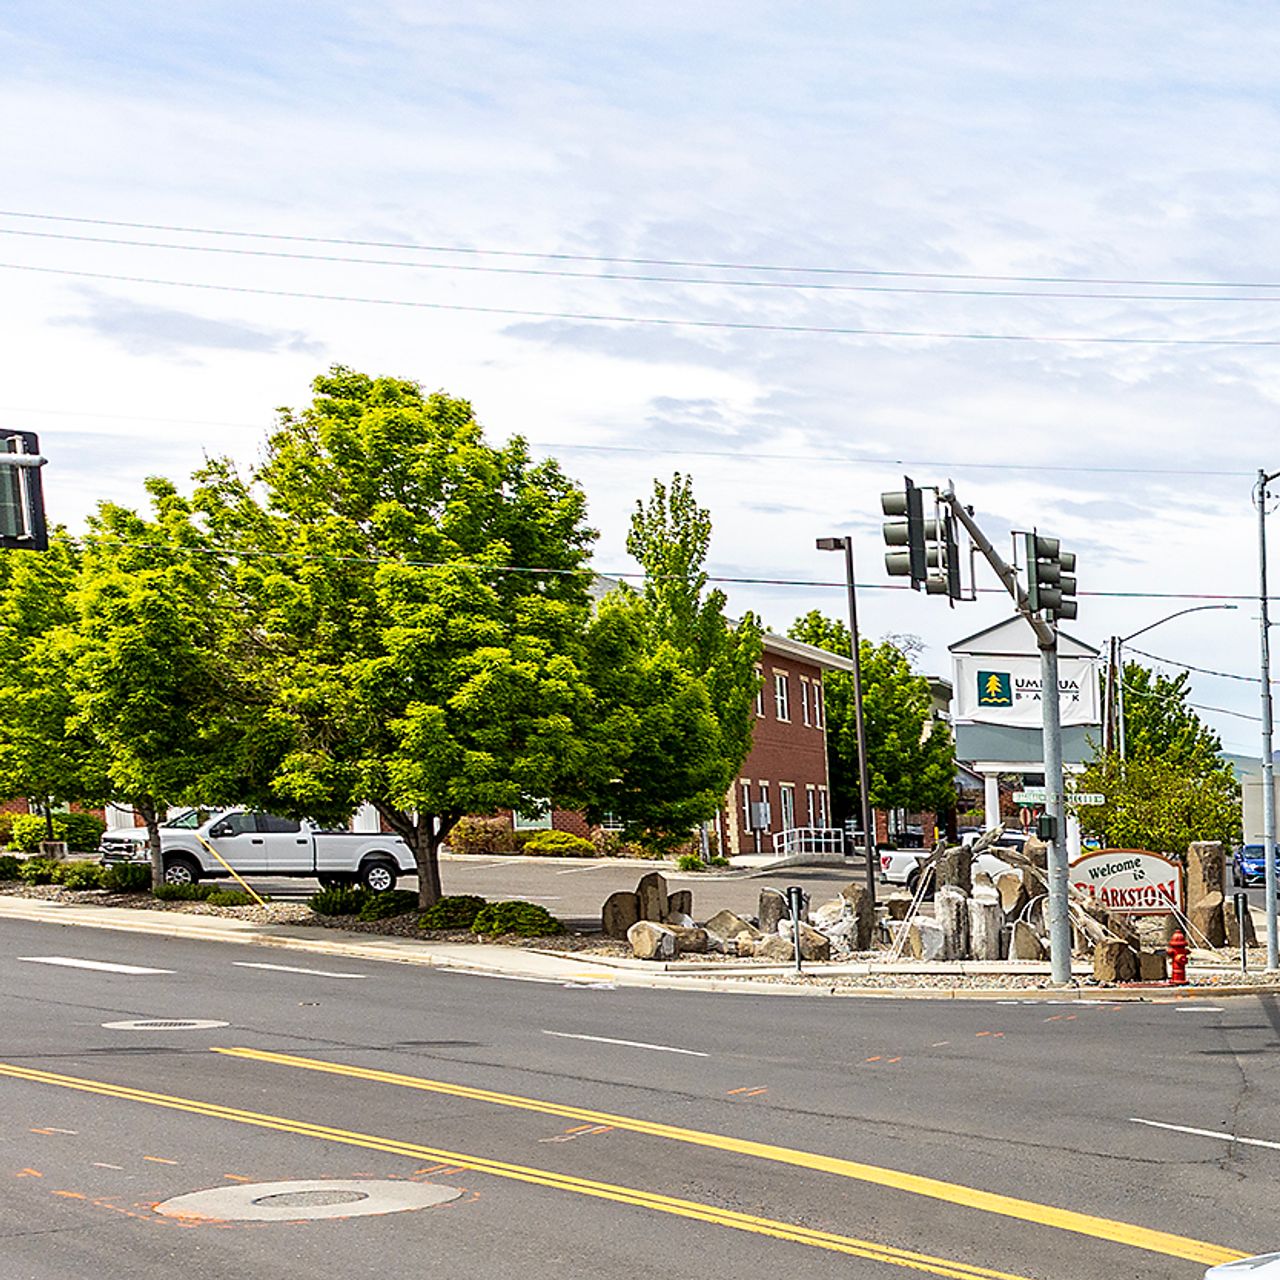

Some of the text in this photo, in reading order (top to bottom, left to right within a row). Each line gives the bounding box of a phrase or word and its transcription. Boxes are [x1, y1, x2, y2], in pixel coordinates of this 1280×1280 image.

[1015, 679, 1080, 689] UMUA
[1088, 857, 1141, 880] Welcome
[1133, 869, 1146, 881] to
